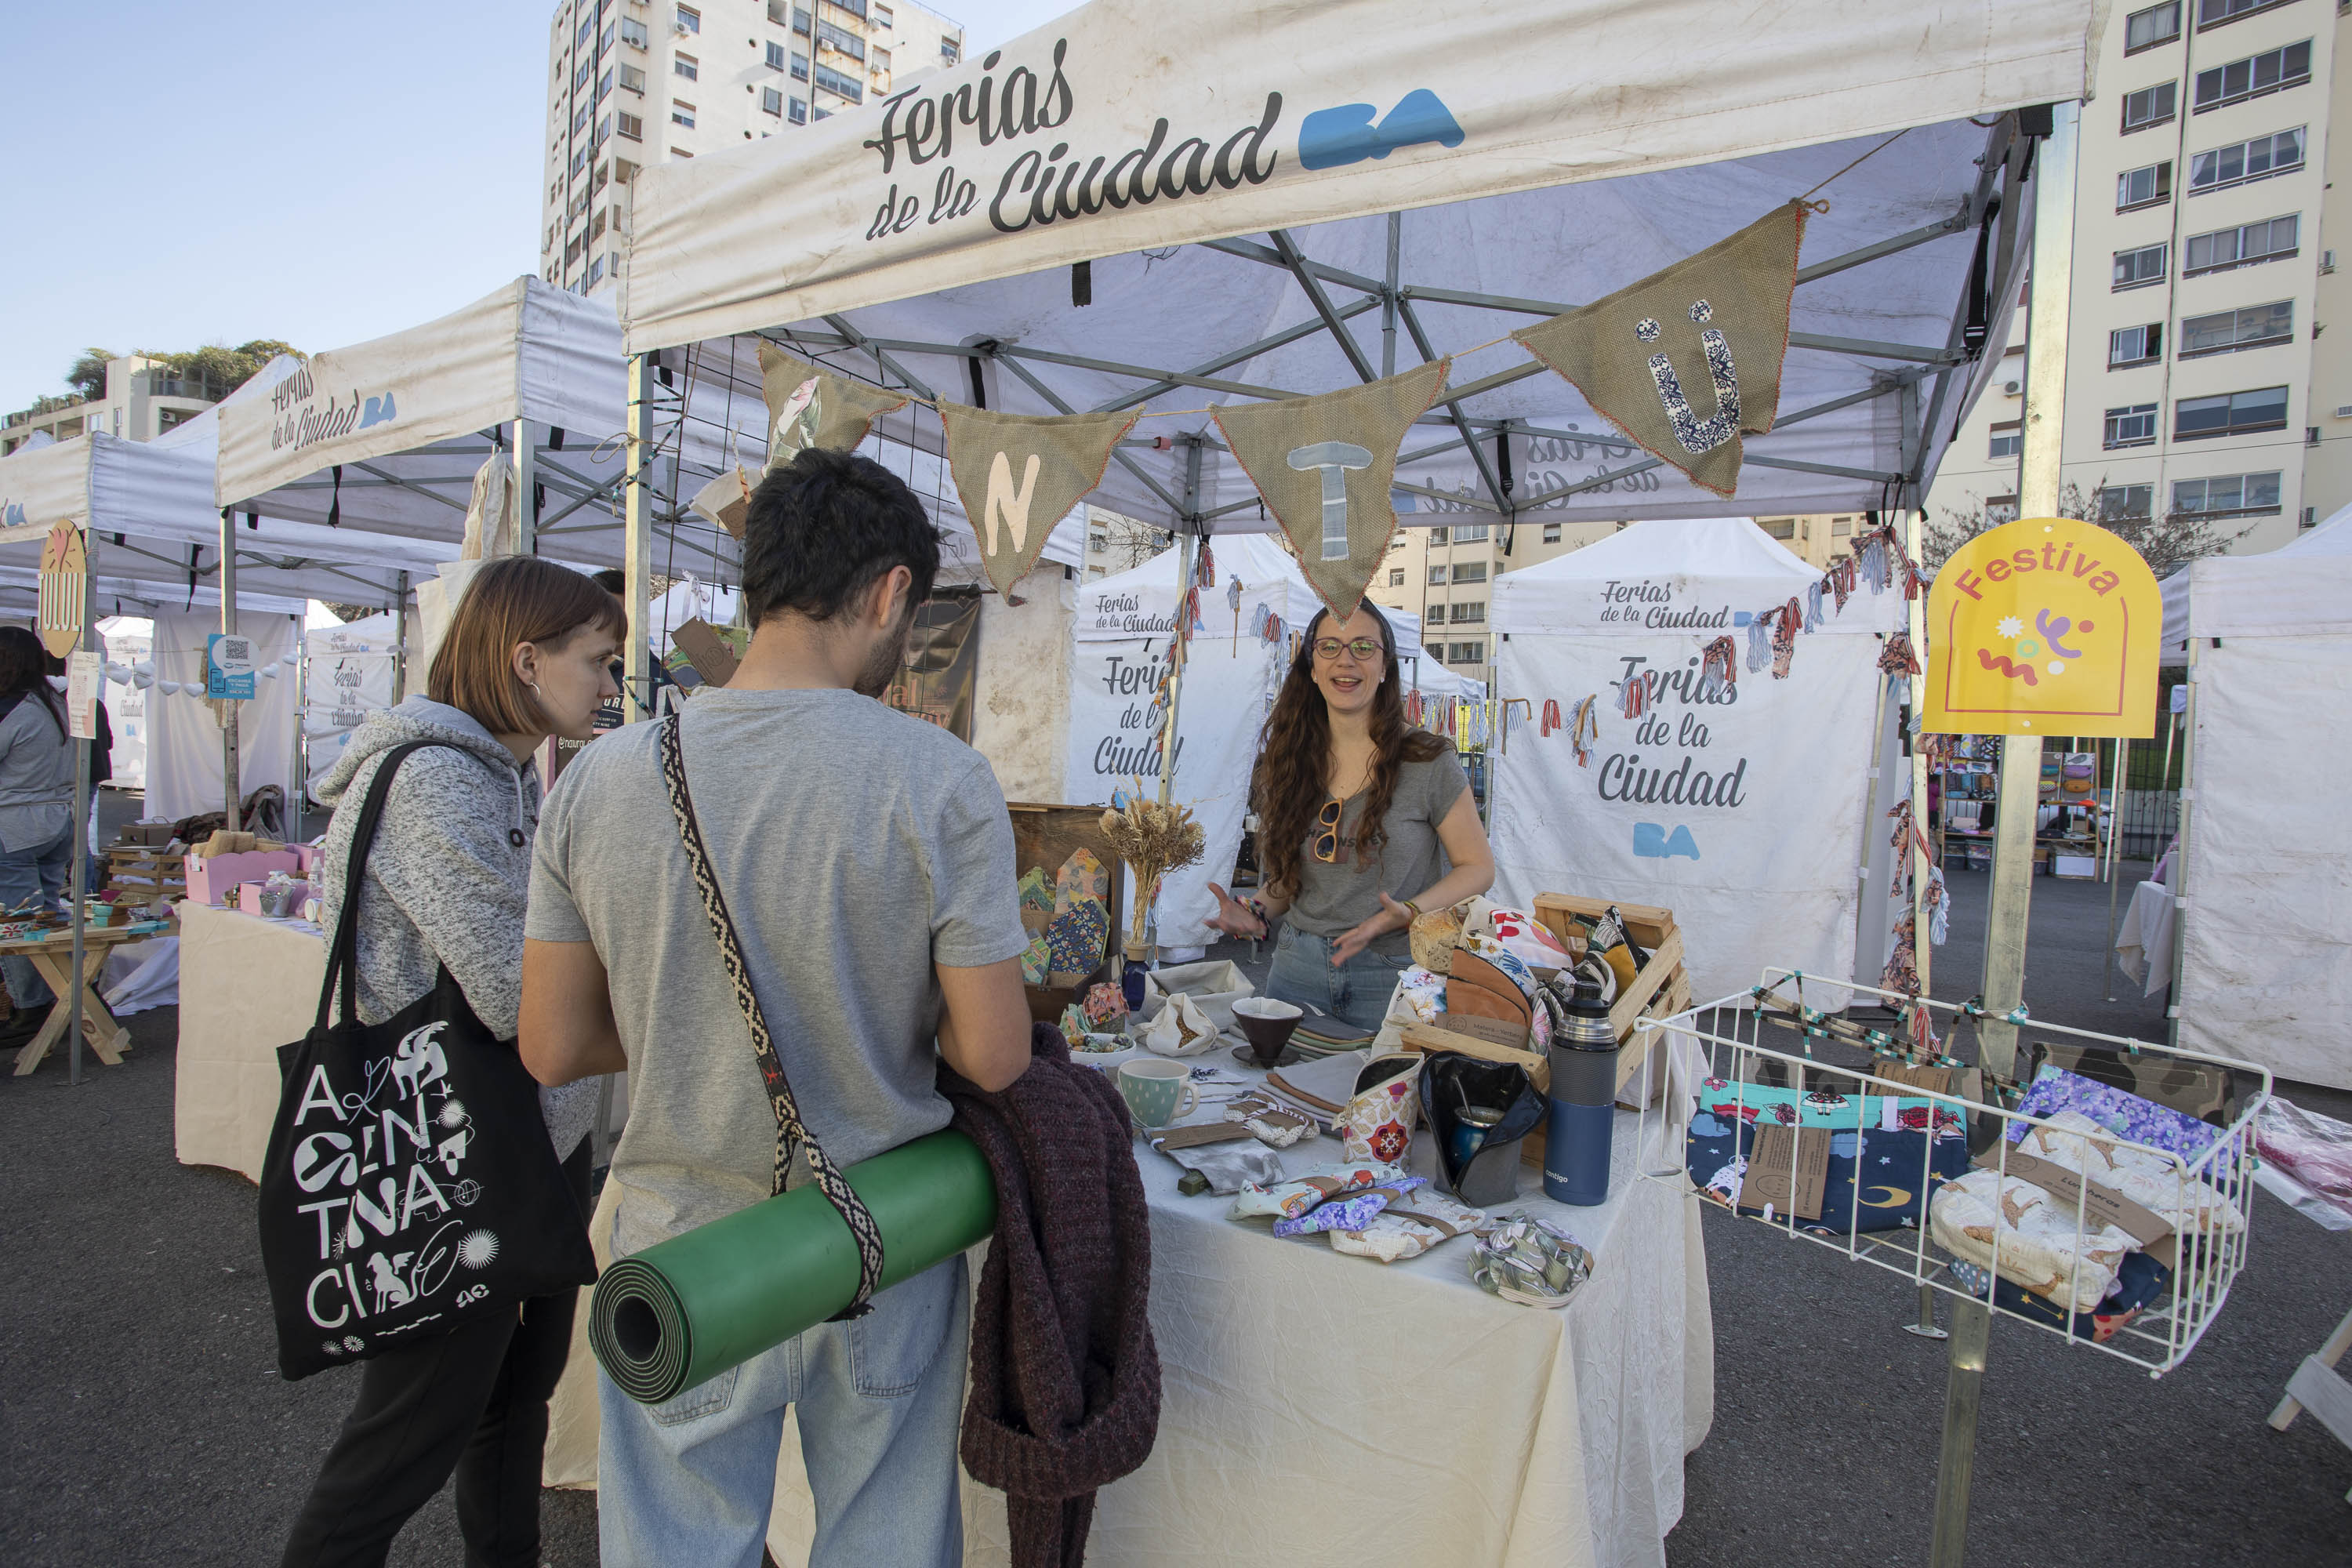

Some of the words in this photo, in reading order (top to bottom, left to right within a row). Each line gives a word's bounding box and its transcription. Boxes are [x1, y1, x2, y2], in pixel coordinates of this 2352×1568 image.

[863, 38, 1073, 174] Ferias
[866, 184, 920, 241] de
[928, 165, 981, 225] la
[989, 92, 1283, 233] Ciudad
[271, 420, 283, 452] de
[285, 413, 295, 445] la
[294, 389, 360, 452] Ciudad
[1953, 540, 2121, 602] Festiva
[1095, 593, 1139, 614] Ferias
[1600, 579, 1671, 603] Ferias
[1096, 615, 1109, 628] de
[1109, 615, 1121, 628] la
[1123, 613, 1176, 633] Ciudad
[1601, 606, 1620, 622] de
[1624, 605, 1641, 622] la
[1646, 605, 1729, 629] Ciudad
[334, 666, 363, 688] Ferias
[1102, 655, 1167, 695] Feri
[1120, 702, 1142, 729] de
[1635, 713, 1671, 746] de
[1679, 712, 1712, 748] la
[1599, 753, 1747, 808] Ciudad
[1545, 1169, 1569, 1184] contigo
[2061, 1176, 2121, 1209] Lunheras
